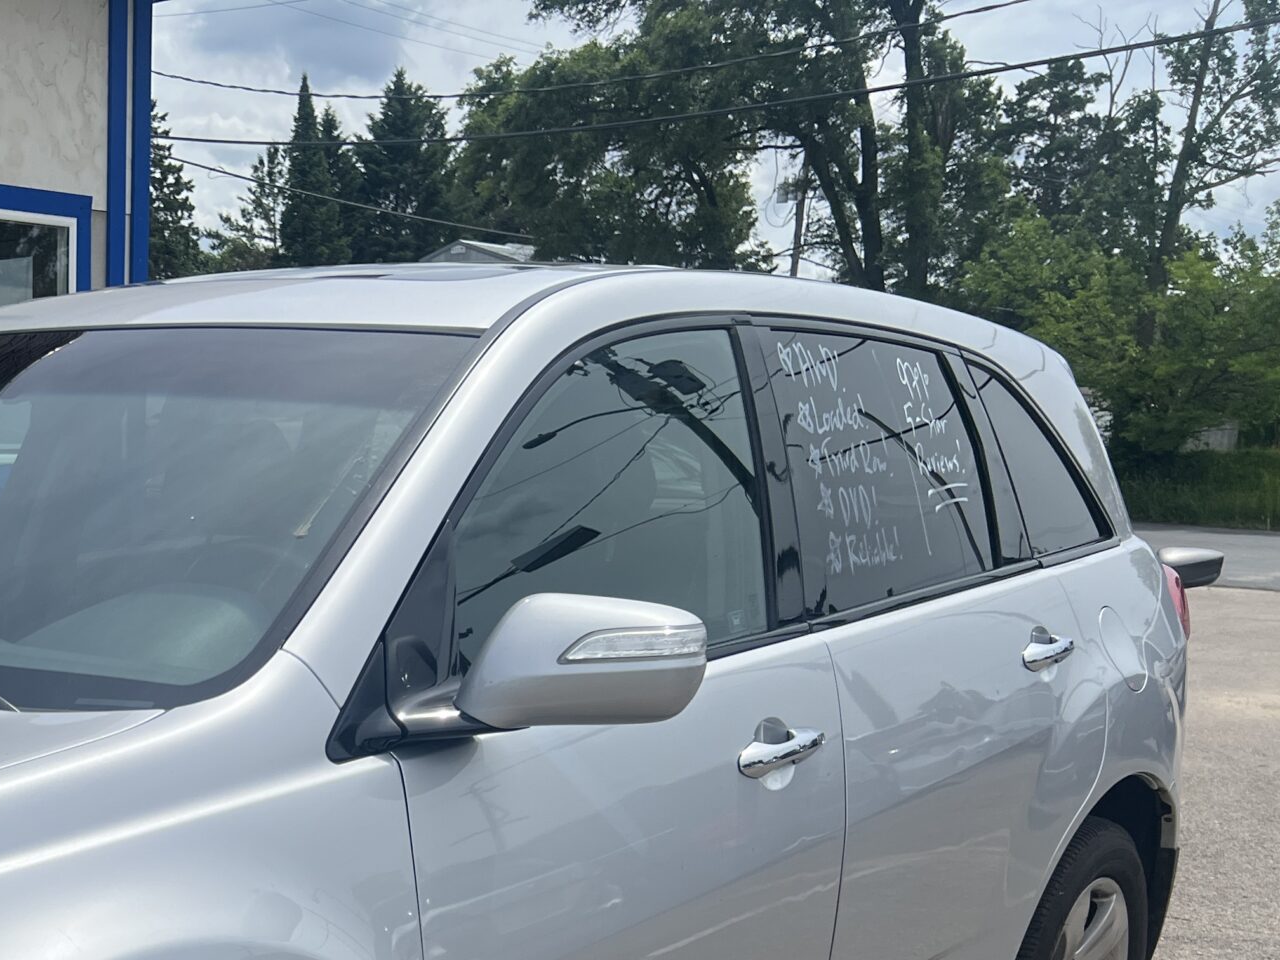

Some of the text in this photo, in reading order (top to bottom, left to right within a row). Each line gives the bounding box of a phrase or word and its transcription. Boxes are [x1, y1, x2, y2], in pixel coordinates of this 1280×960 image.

[809, 393, 868, 434] Loaded!
[904, 401, 948, 439] 5-Star
[915, 440, 966, 477] Reviews!
[838, 485, 878, 528] DVD!
[845, 527, 903, 576] Reliable!
